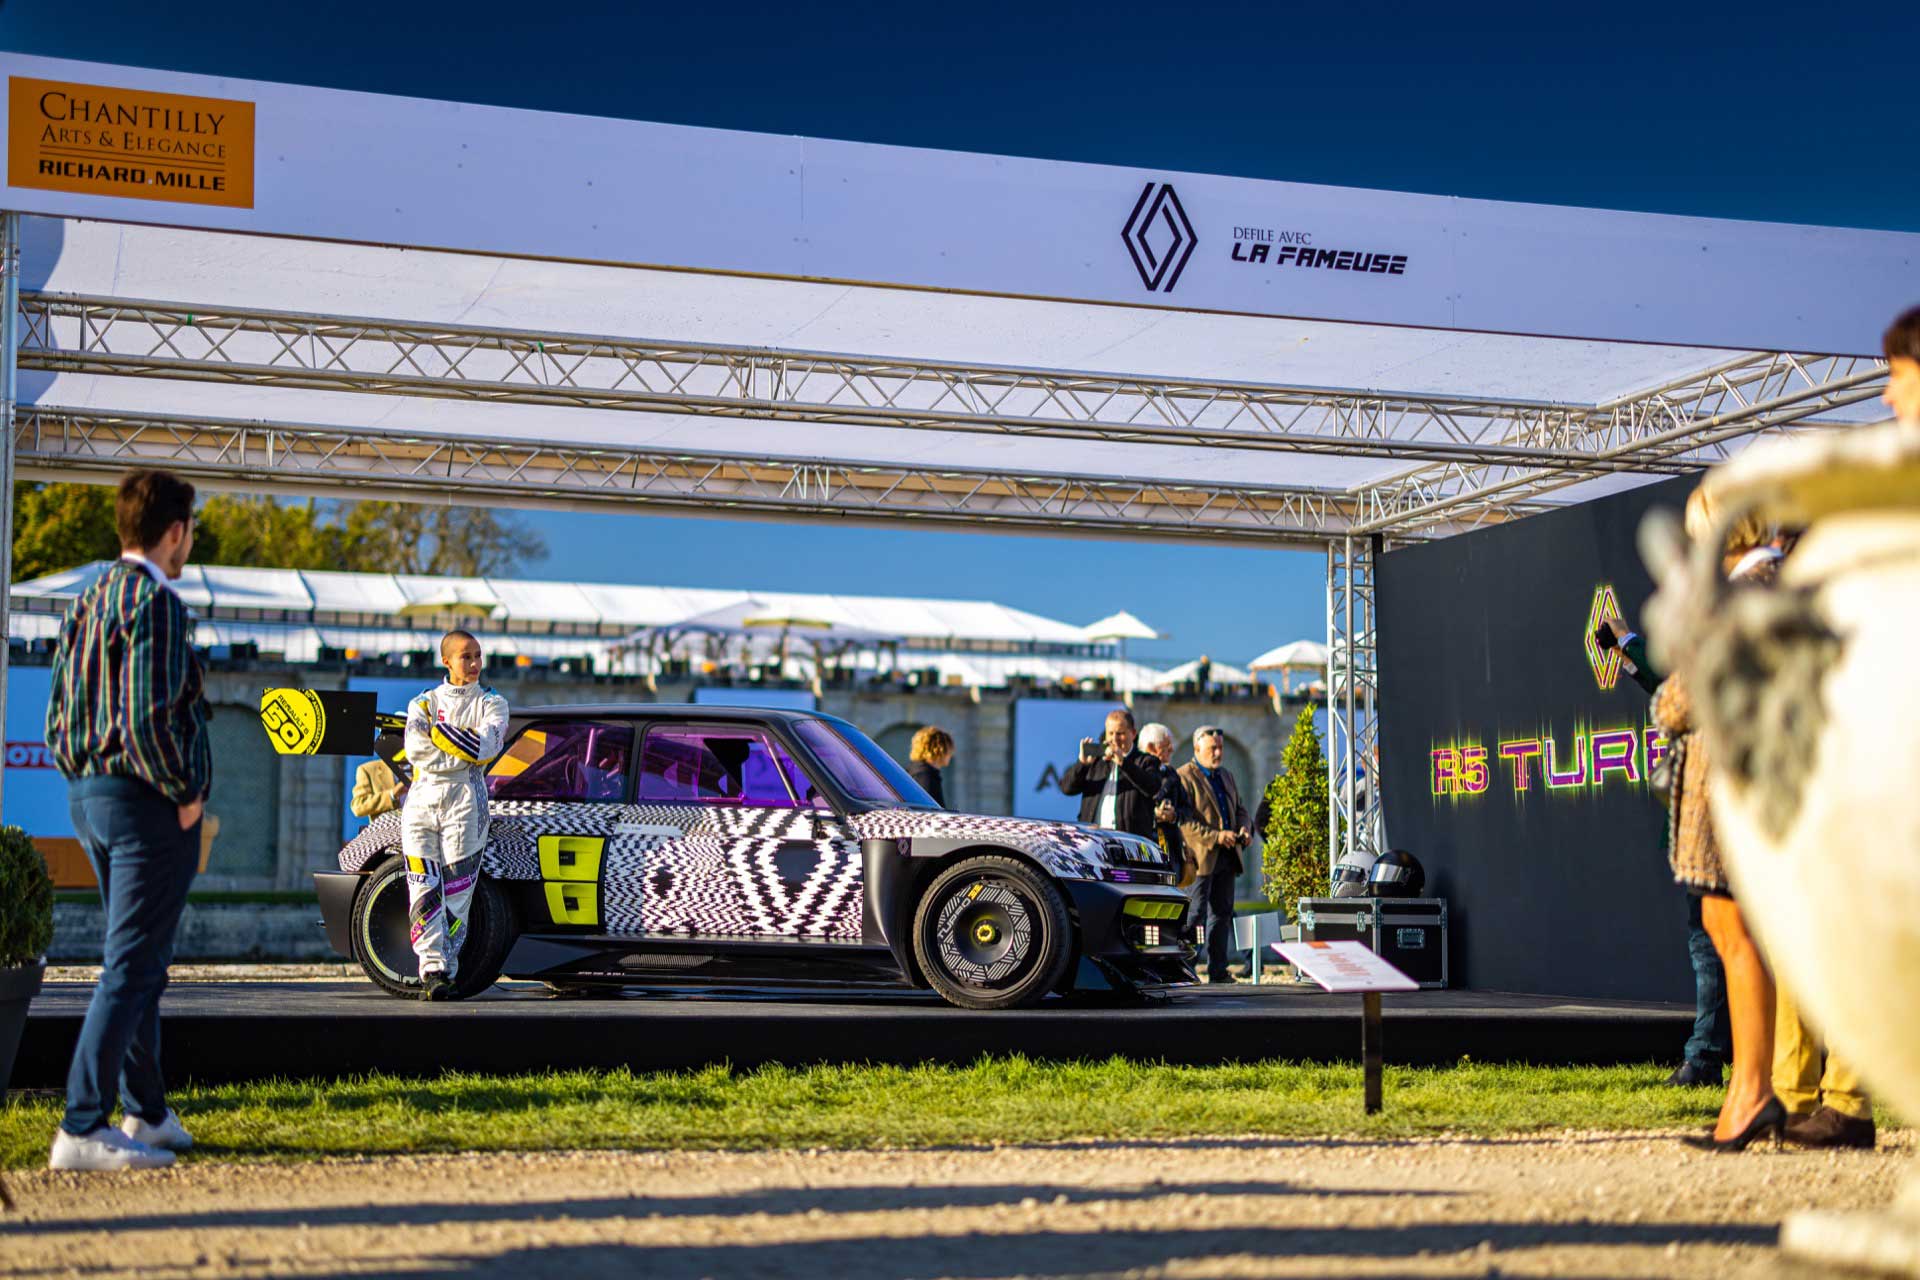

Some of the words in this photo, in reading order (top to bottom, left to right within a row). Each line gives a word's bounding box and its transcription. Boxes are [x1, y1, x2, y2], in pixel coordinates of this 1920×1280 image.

[39, 91, 225, 136] CHANTILLY
[41, 124, 92, 144] ARTS
[99, 131, 115, 148] &
[123, 131, 226, 159] ELEGANCE
[39, 159, 146, 184] RICHARD
[155, 171, 226, 191] MILLE
[1233, 226, 1275, 242] DEFILE
[1278, 230, 1312, 245] AVEC
[1231, 242, 1270, 263] LA
[1277, 246, 1408, 275] FAMEUSE
[260, 699, 305, 750] 50
[1430, 746, 1490, 796] R5
[938, 898, 971, 938] TURBO
